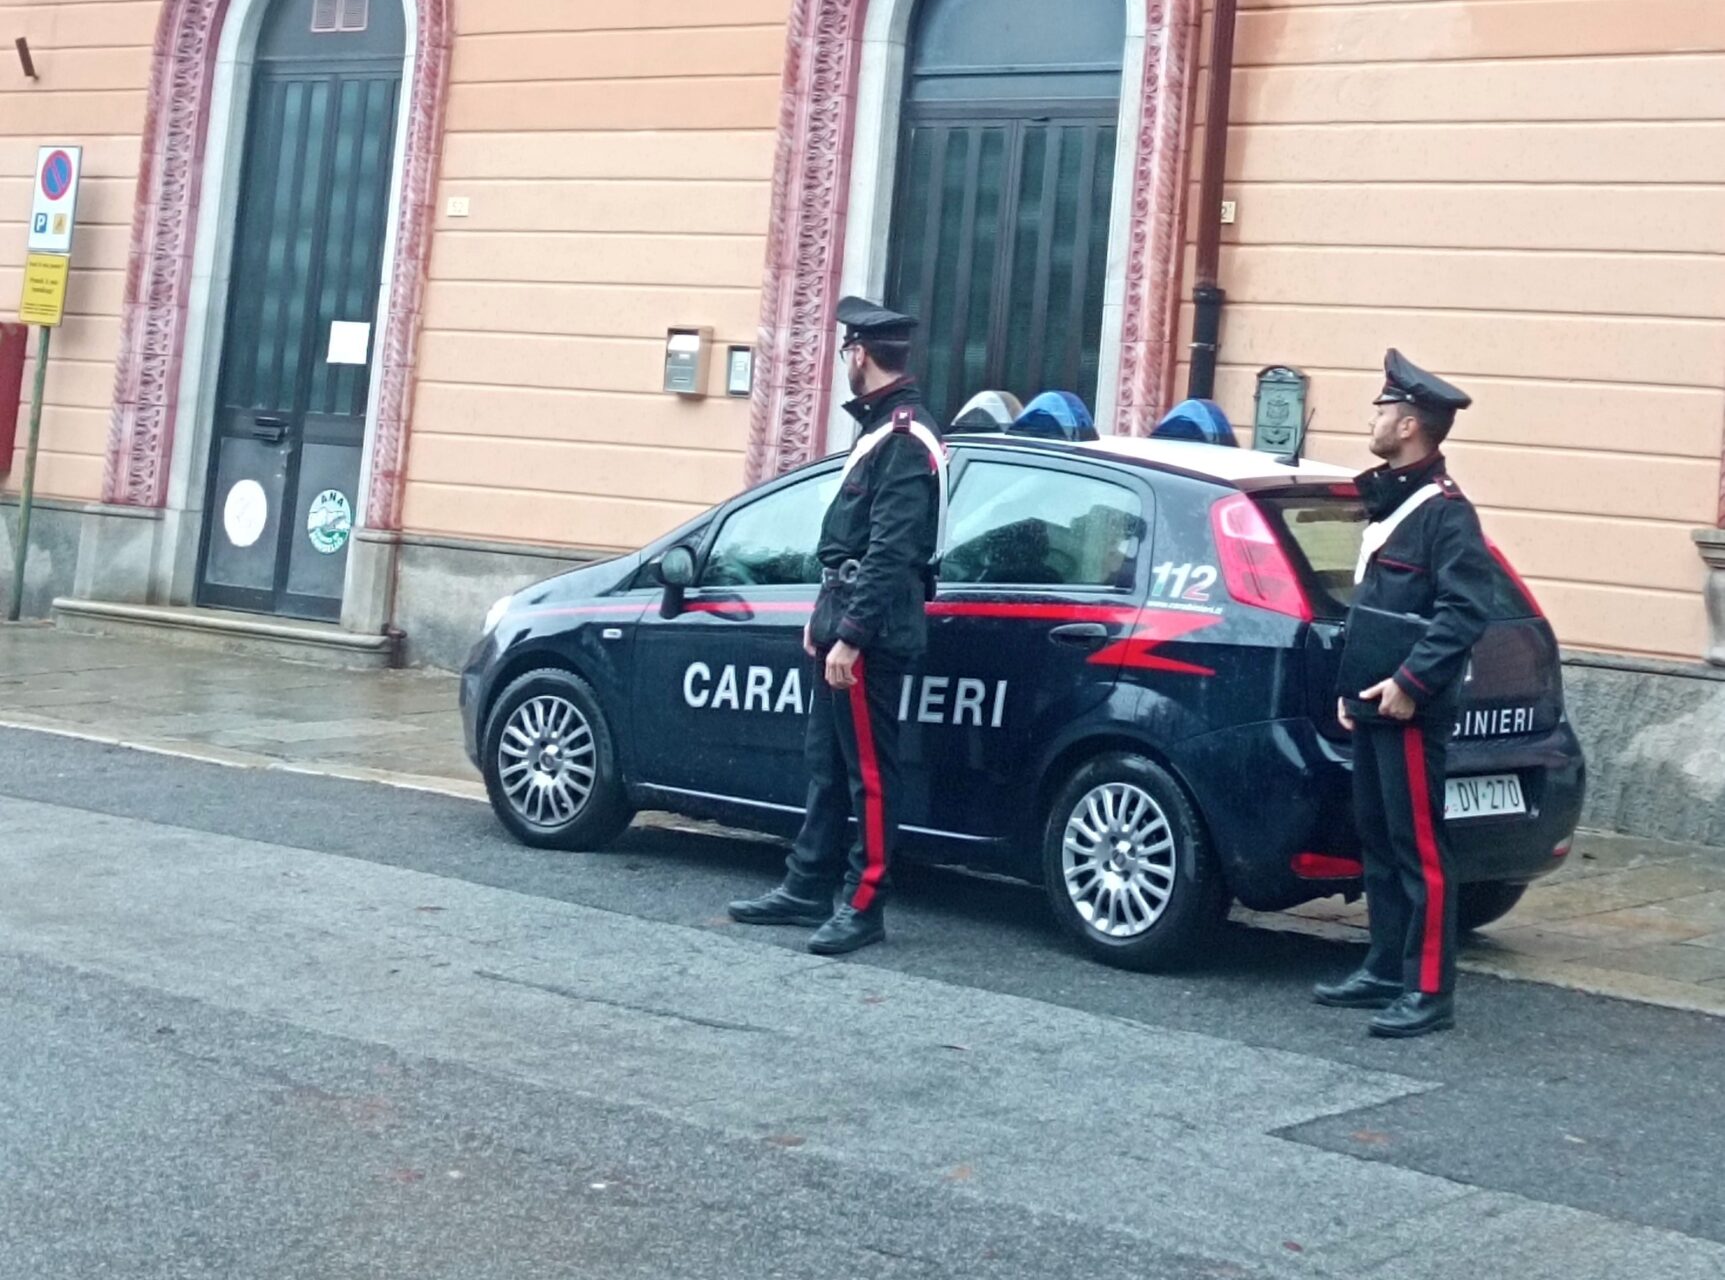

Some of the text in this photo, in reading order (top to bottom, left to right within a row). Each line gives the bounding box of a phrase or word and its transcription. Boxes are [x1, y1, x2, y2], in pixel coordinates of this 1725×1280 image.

[36, 213, 47, 232] P
[321, 491, 344, 507] ANA
[1151, 561, 1217, 602] 112
[683, 661, 1008, 728] CARAIERI
[1457, 779, 1520, 812] DV 270
